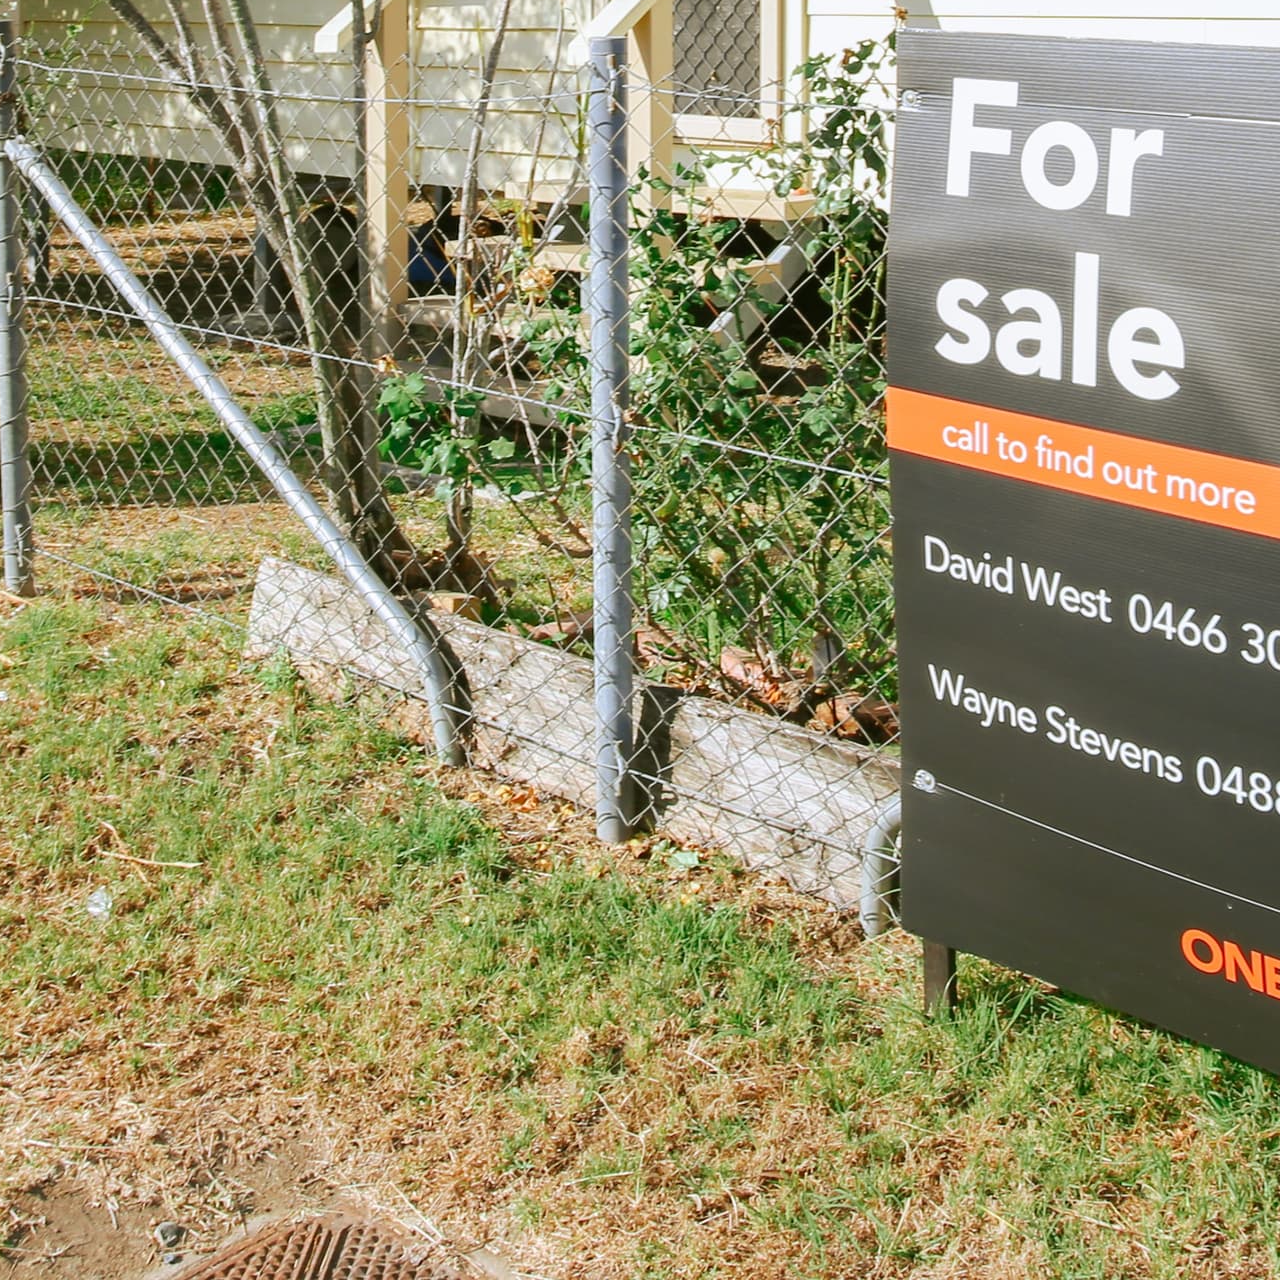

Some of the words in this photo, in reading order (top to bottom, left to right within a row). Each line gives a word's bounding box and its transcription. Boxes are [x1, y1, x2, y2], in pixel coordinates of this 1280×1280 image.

[945, 77, 1164, 217] For
[933, 251, 1186, 402] sale
[941, 420, 989, 455] call
[995, 431, 1028, 464] to
[1034, 434, 1095, 480] find
[1101, 459, 1159, 495] out
[1165, 474, 1257, 516] more
[923, 534, 1014, 595] David
[1020, 561, 1113, 624] West
[1128, 593, 1227, 654] 0466
[927, 663, 1038, 733] Wayne
[1045, 705, 1183, 783] Stevens
